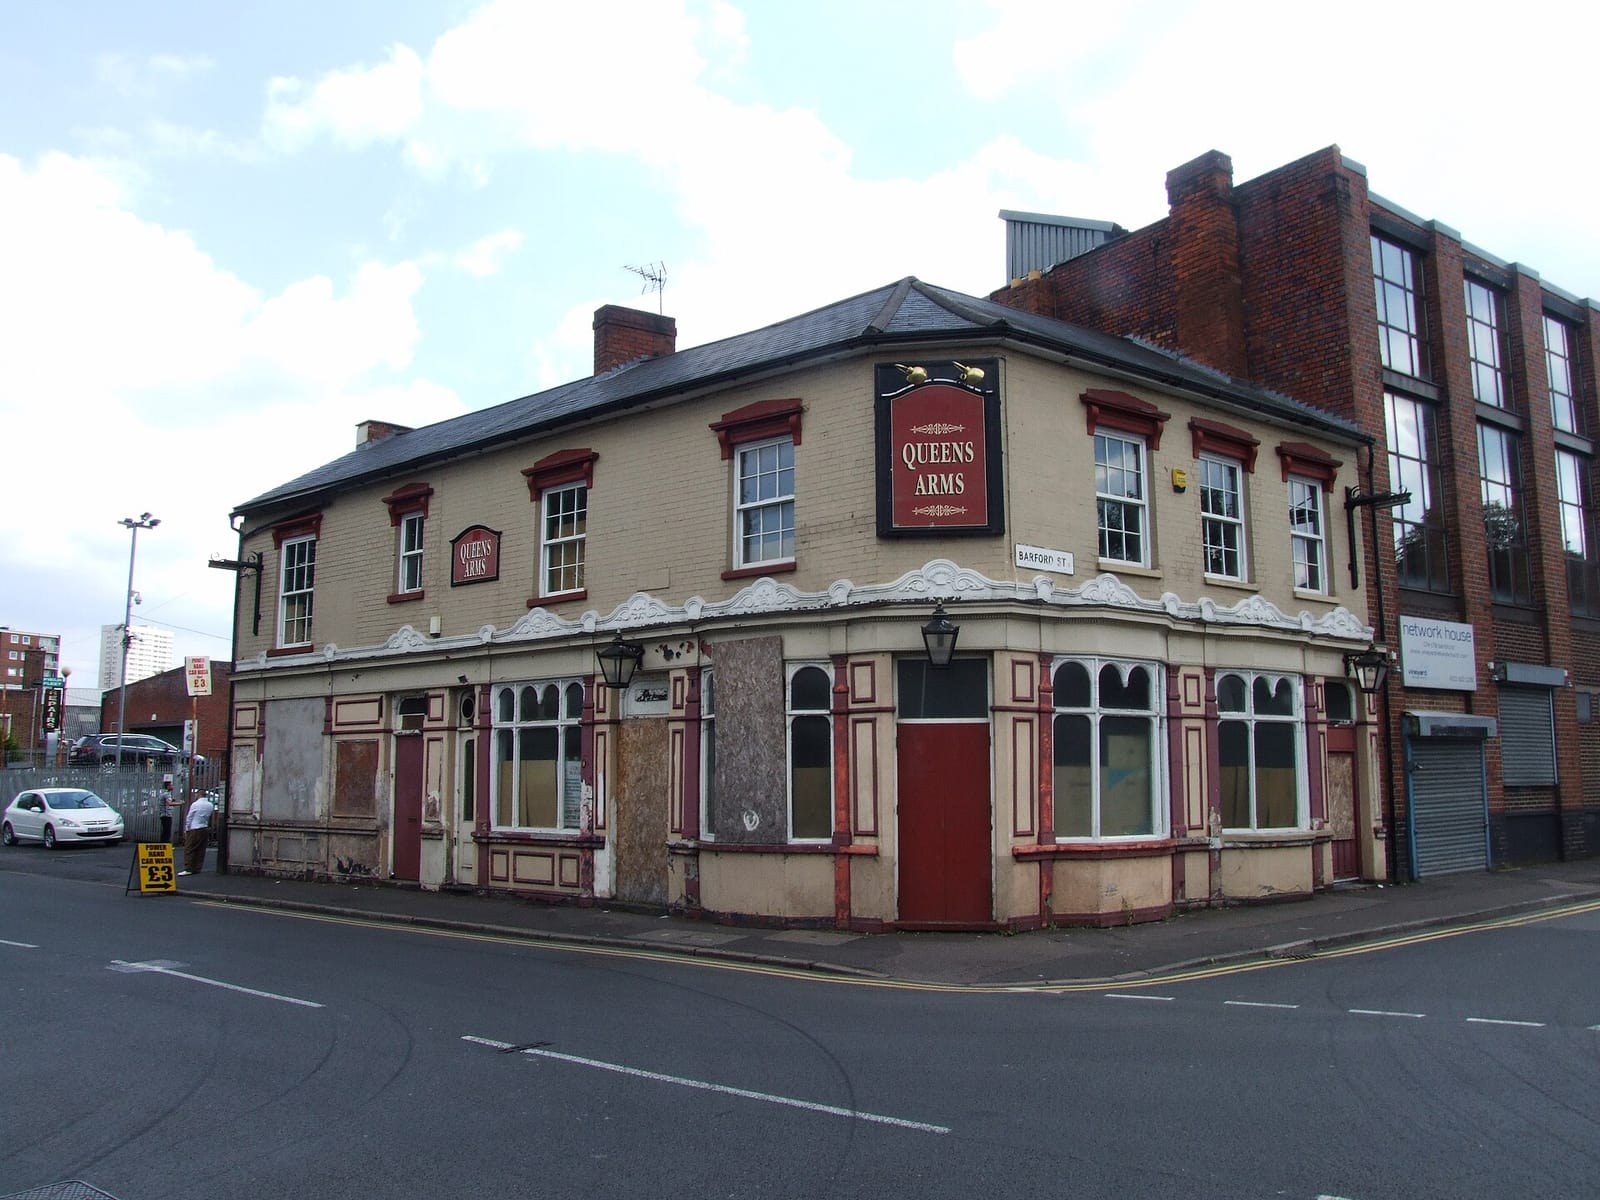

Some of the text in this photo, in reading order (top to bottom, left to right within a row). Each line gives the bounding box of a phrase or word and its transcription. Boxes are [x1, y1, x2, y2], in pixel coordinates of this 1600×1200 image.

[902, 441, 975, 470] QUEENS
[914, 472, 965, 495] ARMS
[460, 539, 492, 564] QUEENS
[1018, 550, 1054, 565] BARFORD
[464, 558, 486, 577] ARMS
[1402, 622, 1472, 642] network house
[148, 865, 174, 882] £3
